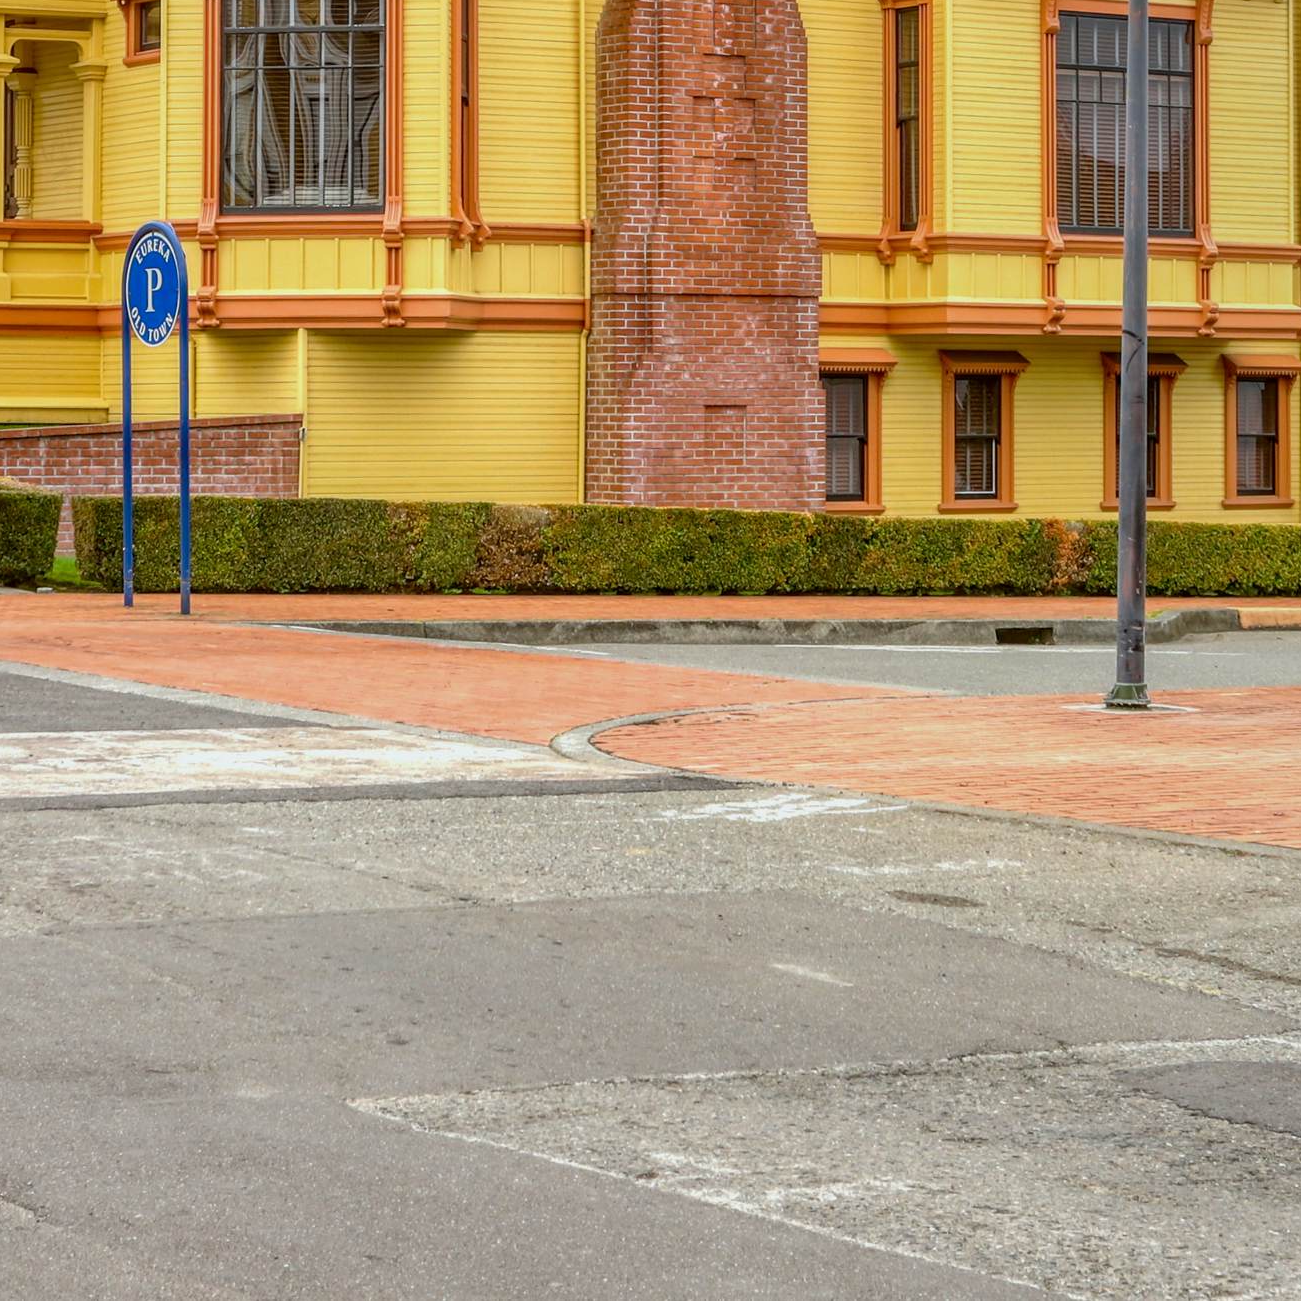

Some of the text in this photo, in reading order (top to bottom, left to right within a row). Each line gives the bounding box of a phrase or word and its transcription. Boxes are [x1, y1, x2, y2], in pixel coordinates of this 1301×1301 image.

[135, 239, 170, 264] EUREKA
[144, 267, 163, 312] P
[131, 306, 174, 342] OLD TOWN
